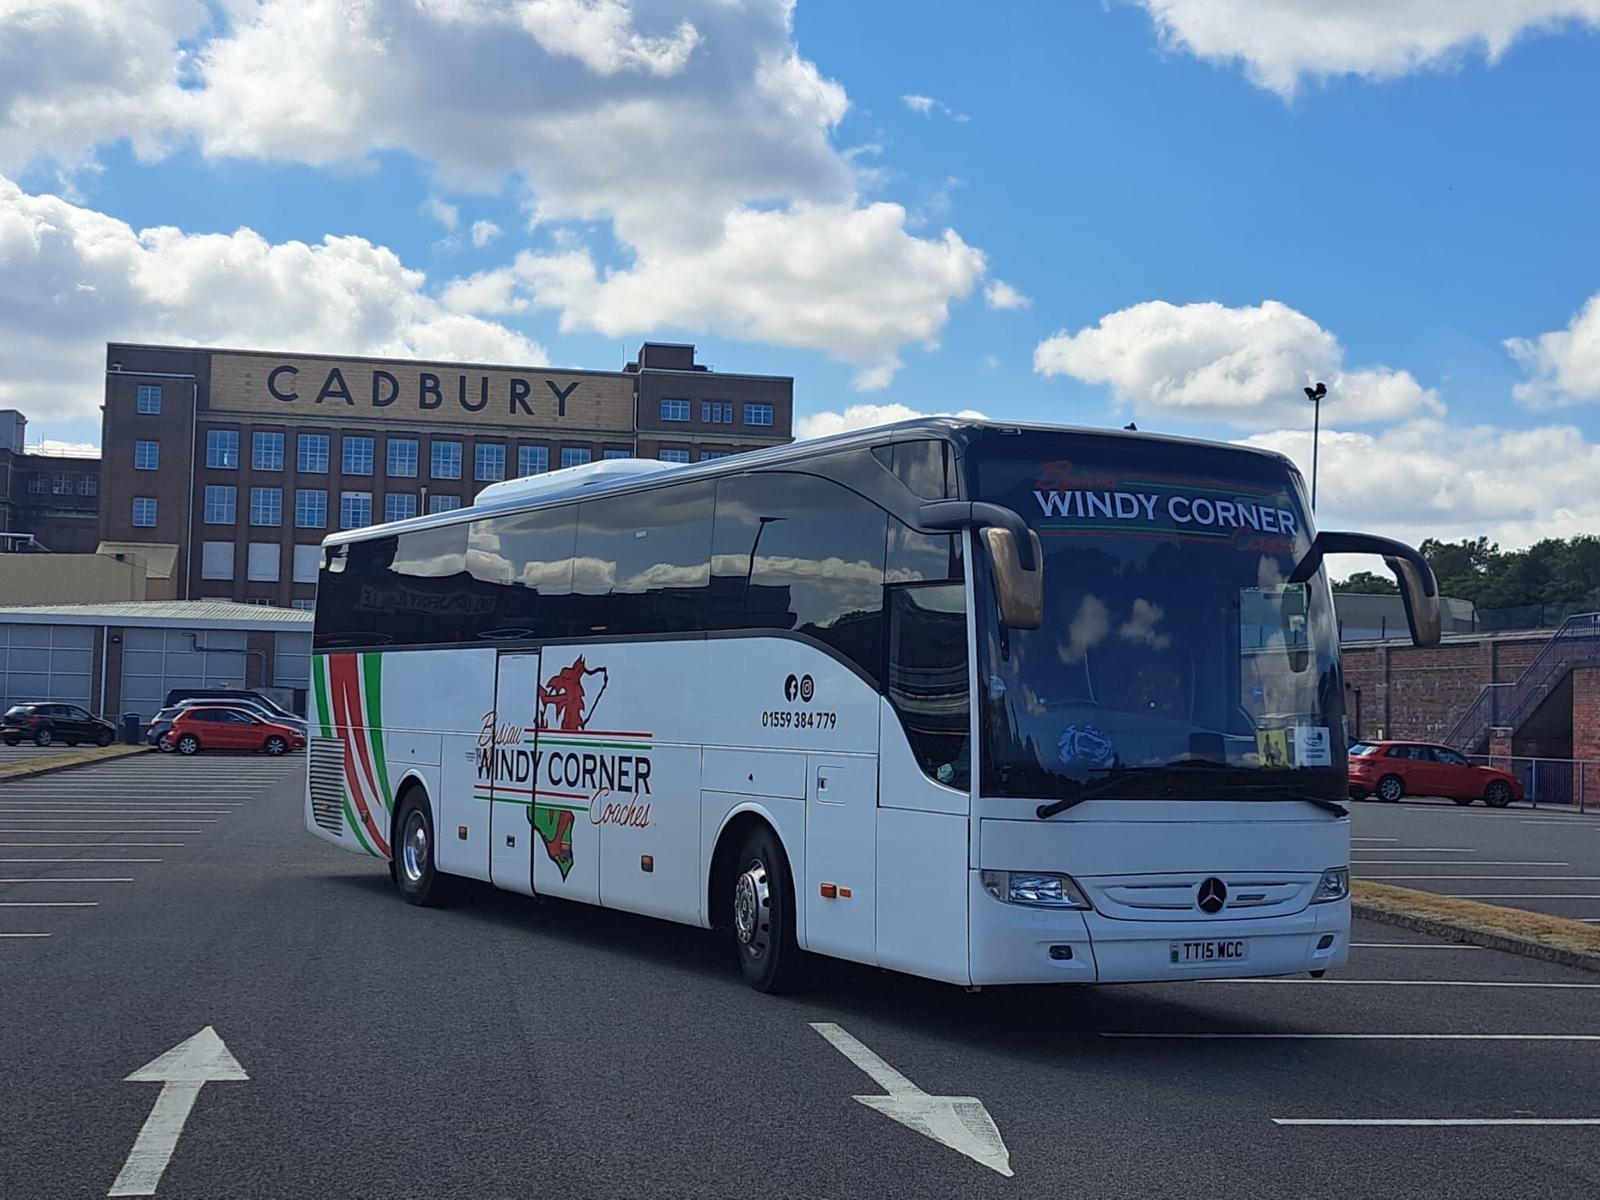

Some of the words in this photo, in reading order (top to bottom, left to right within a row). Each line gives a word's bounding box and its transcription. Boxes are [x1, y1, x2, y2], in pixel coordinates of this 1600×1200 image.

[267, 365, 579, 416] CADBURY
[1033, 490, 1158, 520] WINDY
[1167, 496, 1296, 534] CORNER
[762, 711, 792, 727] 01559
[794, 712, 814, 728] 384
[816, 713, 837, 729] 779
[475, 747, 543, 785] WINDY
[548, 752, 652, 795] CORNER
[589, 786, 650, 828] Coaches
[1184, 943, 1214, 959] TT15
[1217, 941, 1244, 959] WCC
